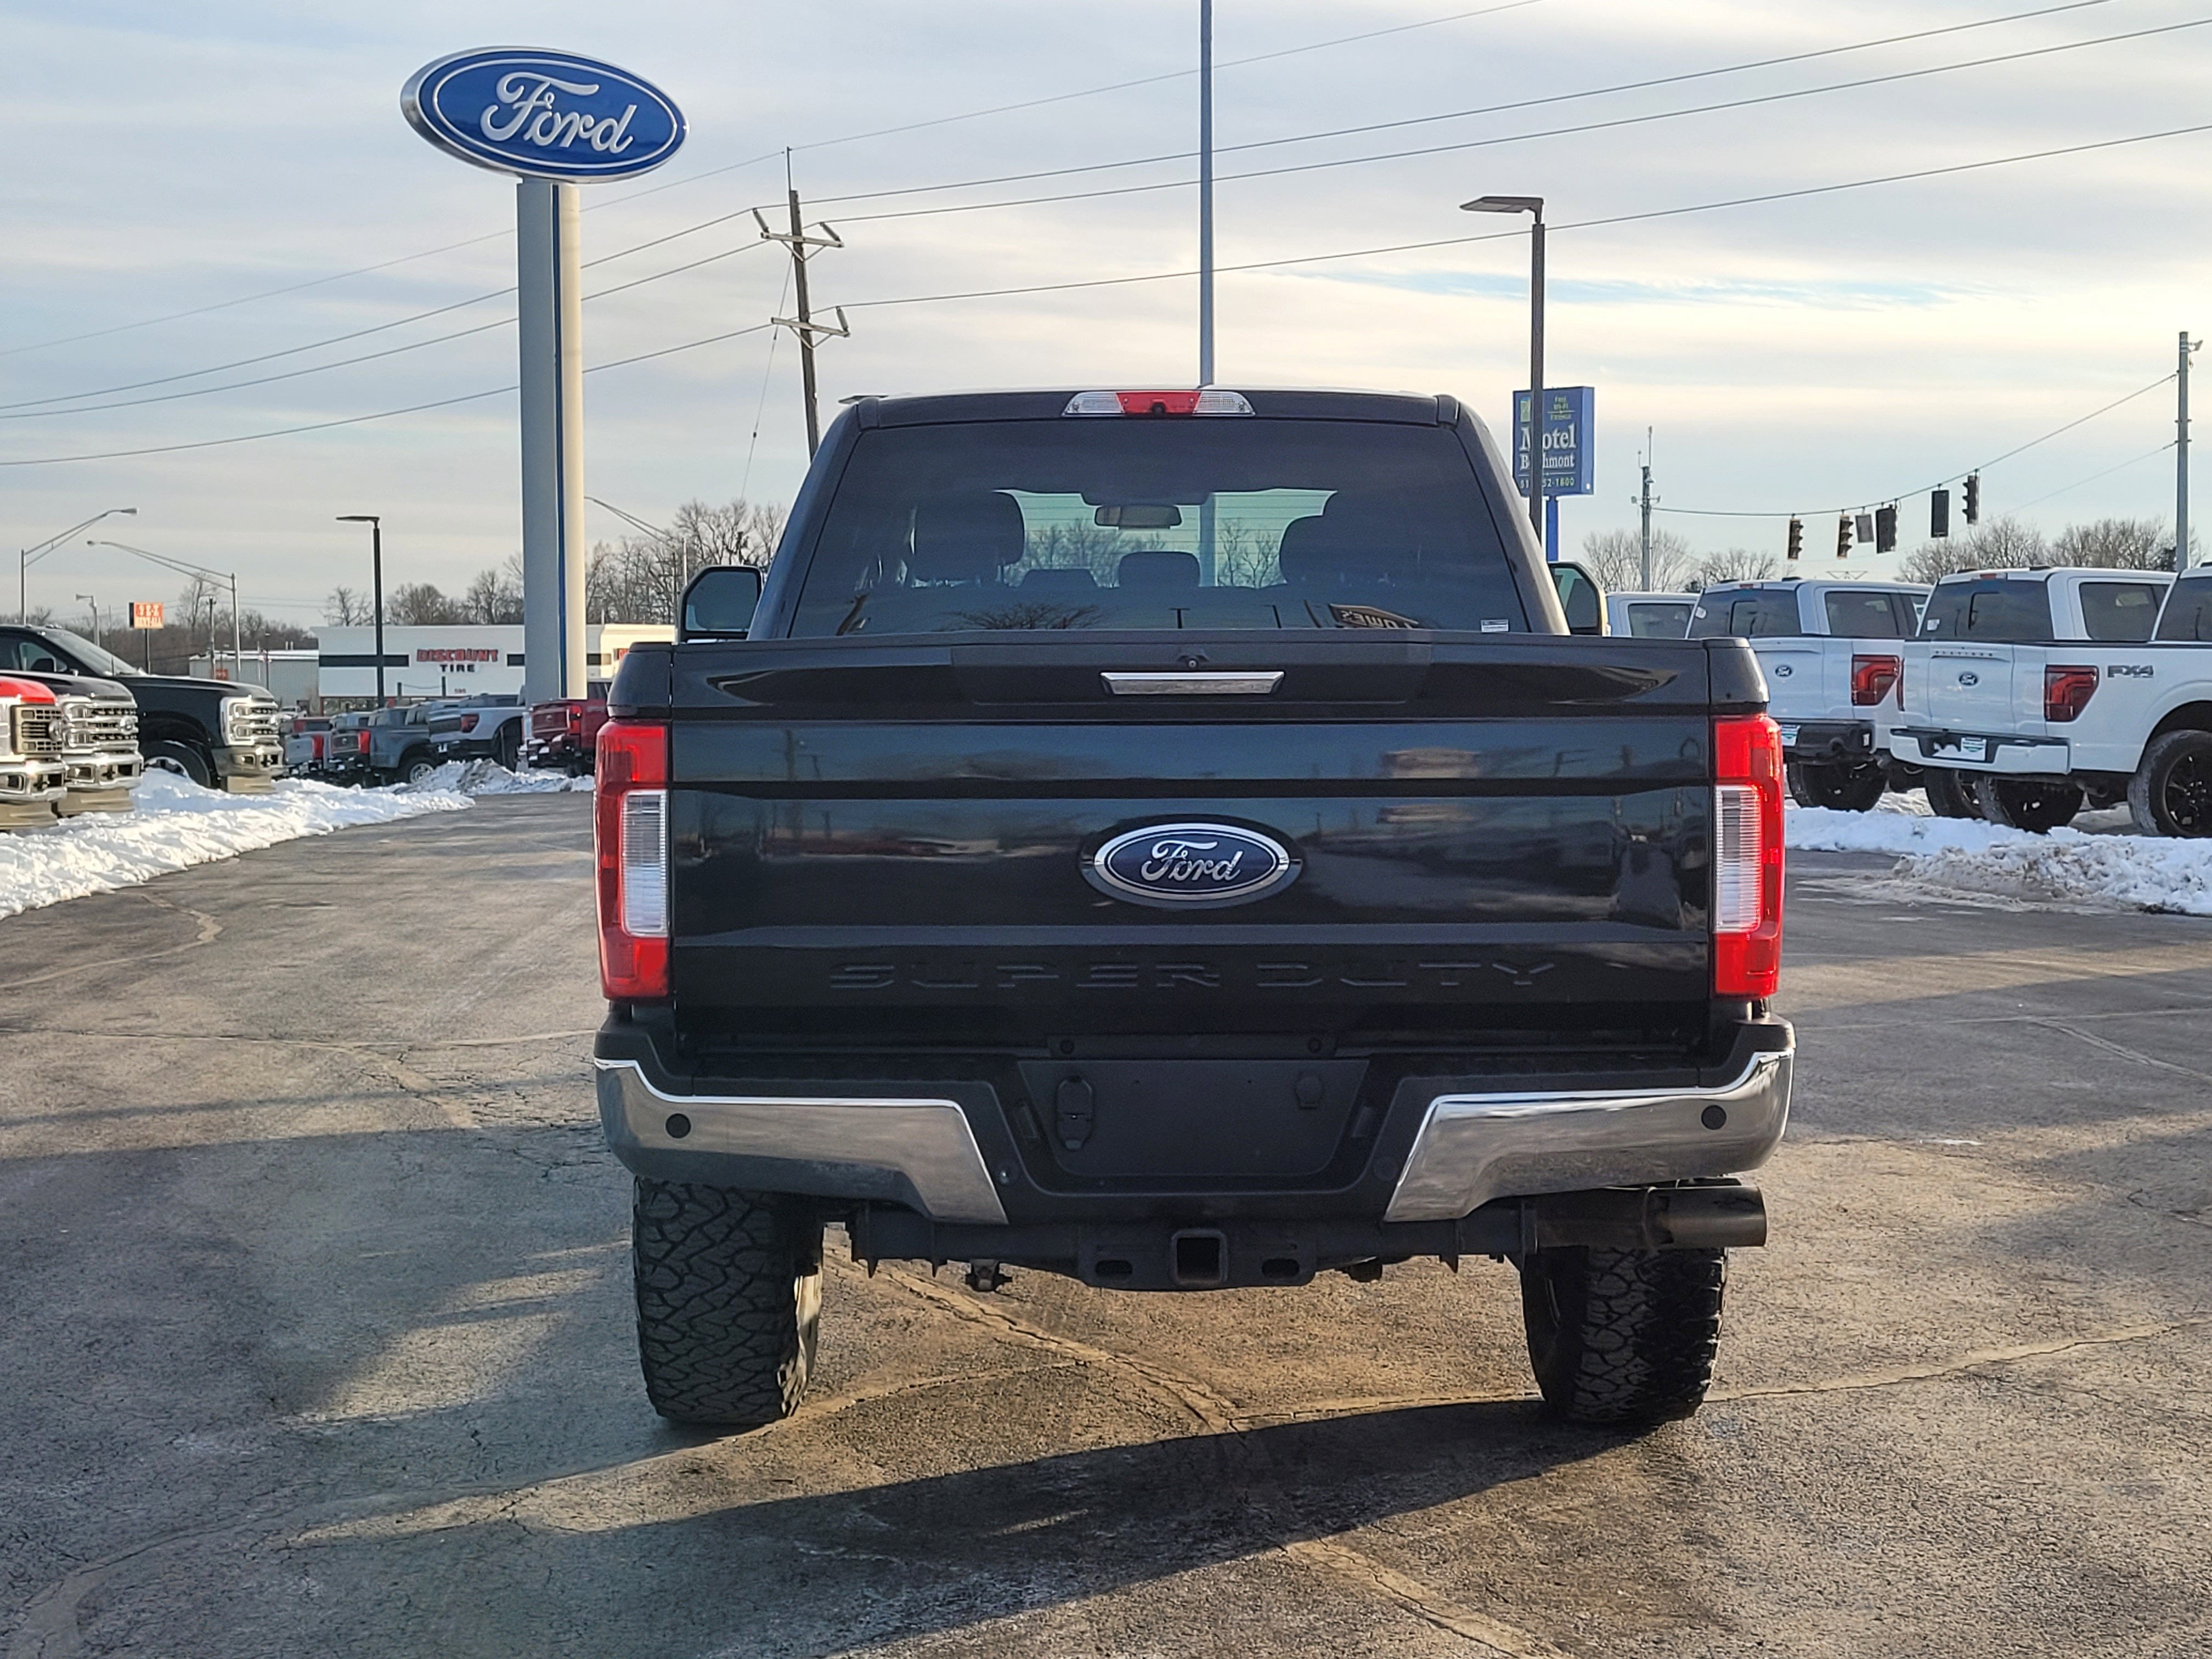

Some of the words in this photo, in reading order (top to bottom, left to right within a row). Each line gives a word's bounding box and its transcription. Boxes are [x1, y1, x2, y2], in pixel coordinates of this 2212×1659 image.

[479, 71, 637, 154] Ford
[1519, 451, 1575, 471] Bhmont
[417, 648, 498, 662] DISCOUNT
[440, 664, 475, 672] TIRE
[2107, 665, 2153, 678] FX4
[1141, 839, 1245, 882] Ford
[830, 964, 1219, 989] SUPER
[1256, 963, 1555, 988] DUTY
